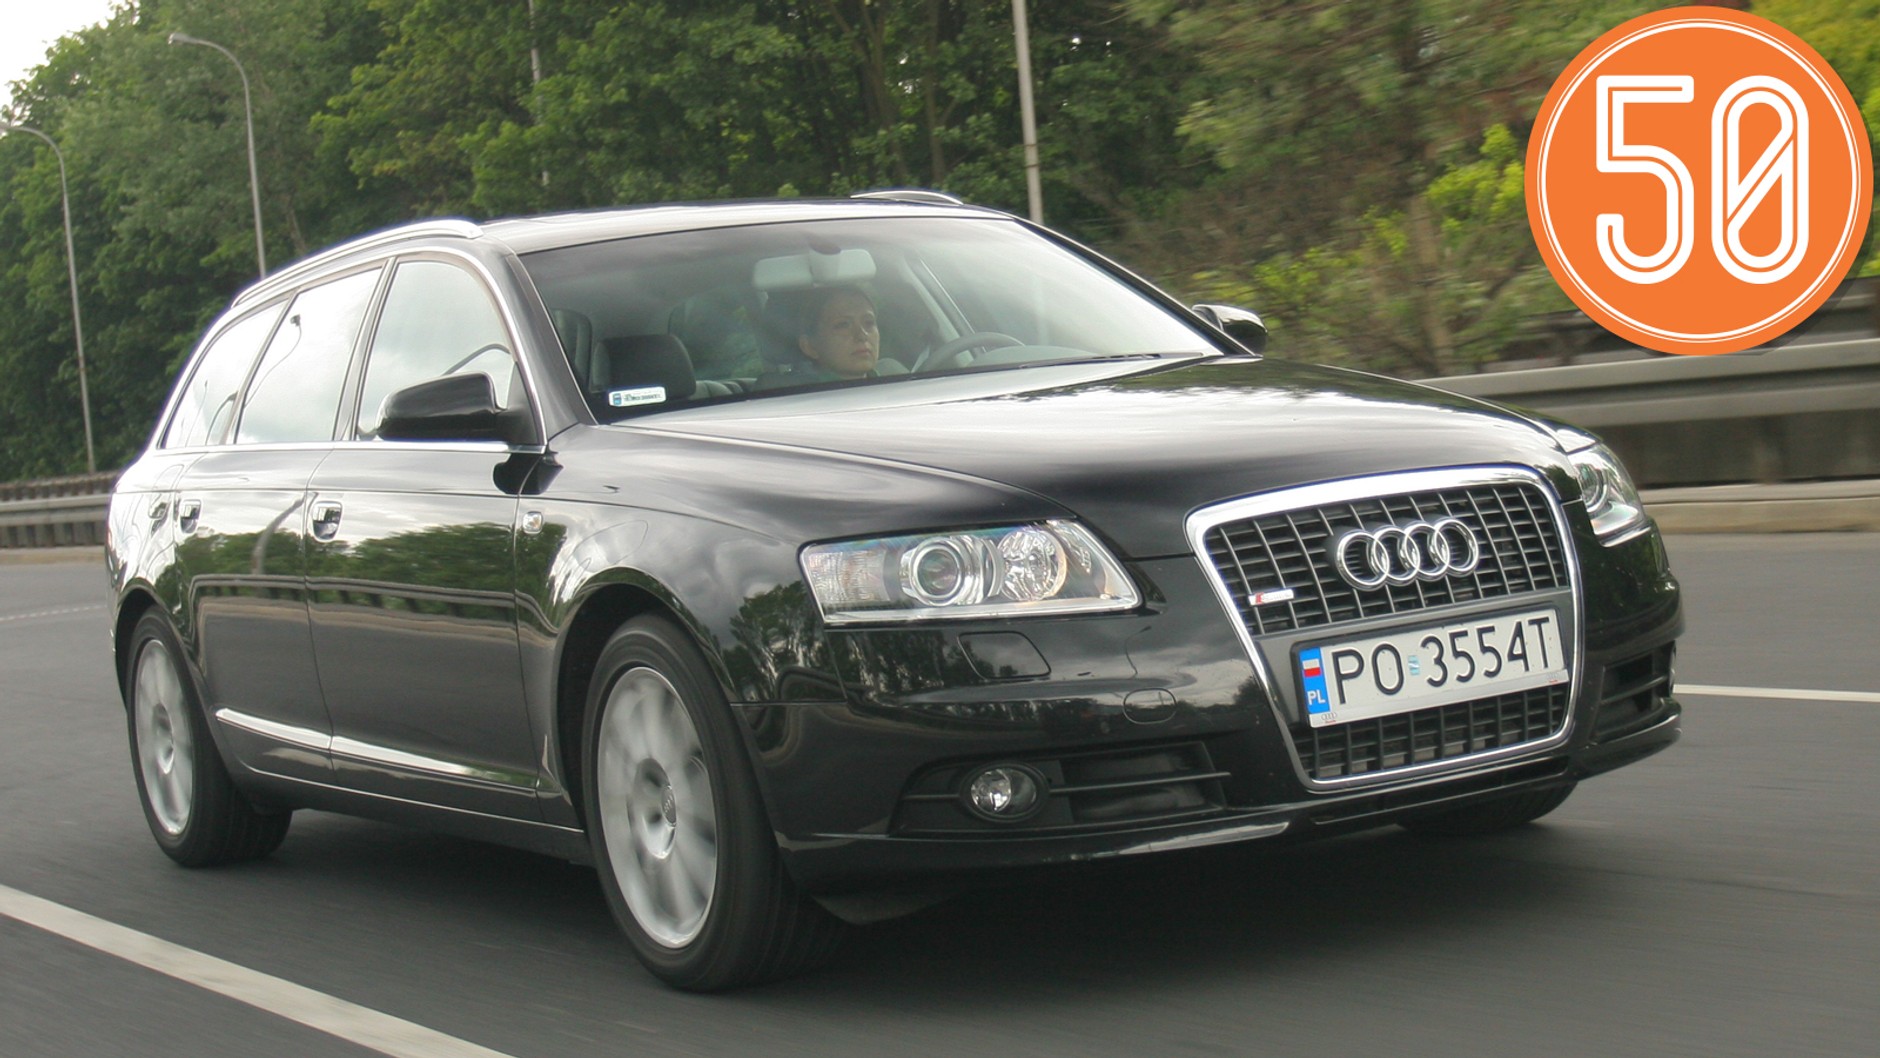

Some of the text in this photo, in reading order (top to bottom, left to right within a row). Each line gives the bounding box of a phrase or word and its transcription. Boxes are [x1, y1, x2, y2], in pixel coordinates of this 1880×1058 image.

[1331, 616, 1550, 704] PO 3554T
[1307, 689, 1326, 705] PL
